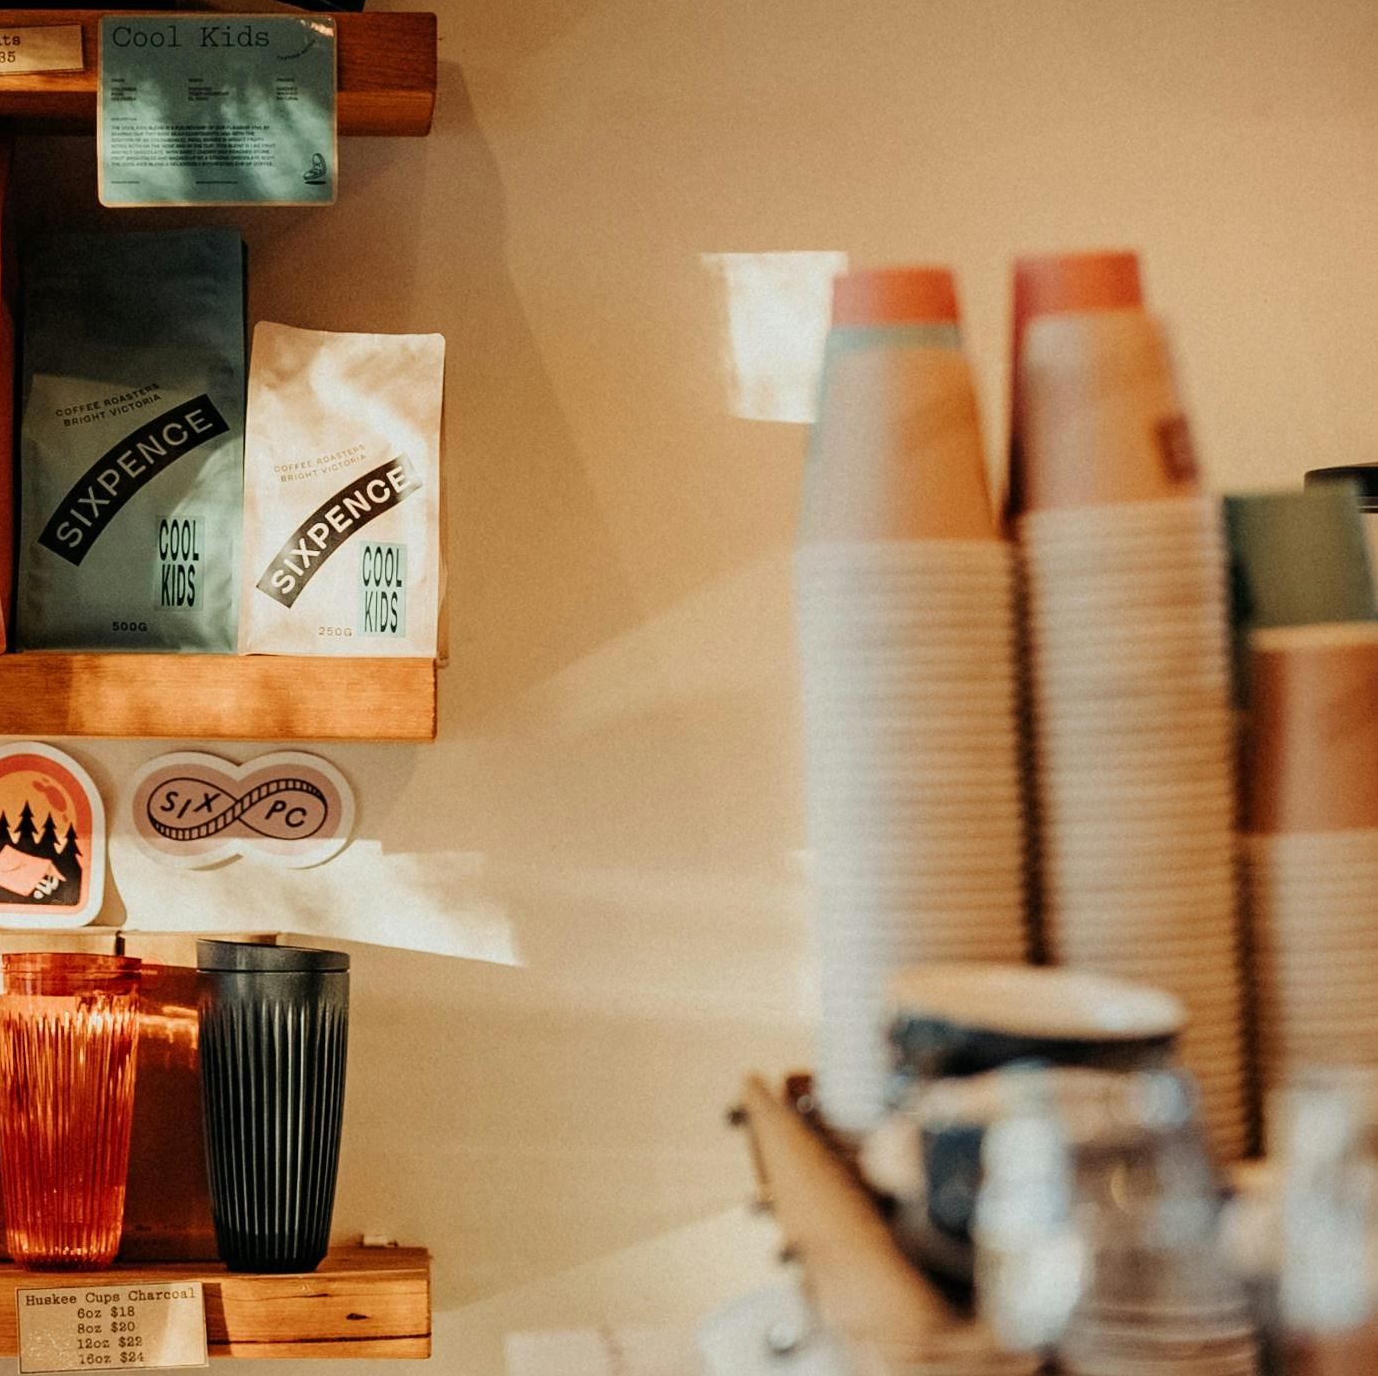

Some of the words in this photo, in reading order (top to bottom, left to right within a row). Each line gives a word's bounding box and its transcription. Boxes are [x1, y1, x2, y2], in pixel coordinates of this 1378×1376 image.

[112, 26, 181, 48] Cool
[200, 26, 270, 48] Kids
[57, 408, 214, 548] SIXPENCE
[159, 519, 199, 561] COOL
[271, 466, 411, 595] SIXPENCE
[362, 546, 403, 587] COOL
[161, 564, 196, 607] KIDS
[364, 591, 398, 632] KIDS
[112, 622, 147, 632] 500G
[319, 627, 353, 637] 250G
[159, 792, 221, 818] SIX
[265, 800, 307, 828] PC
[25, 1294, 77, 1306] Huskee
[85, 1292, 120, 1305] Cups
[128, 1287, 196, 1302] Charcoal
[77, 1308, 102, 1319] 6oz
[110, 1306, 135, 1318] $18
[77, 1324, 102, 1334] 8oz
[110, 1323, 135, 1334] $20
[77, 1339, 110, 1349] 12oz
[118, 1336, 143, 1348] $22
[78, 1354, 111, 1364] 16oz
[119, 1351, 144, 1363] $24
